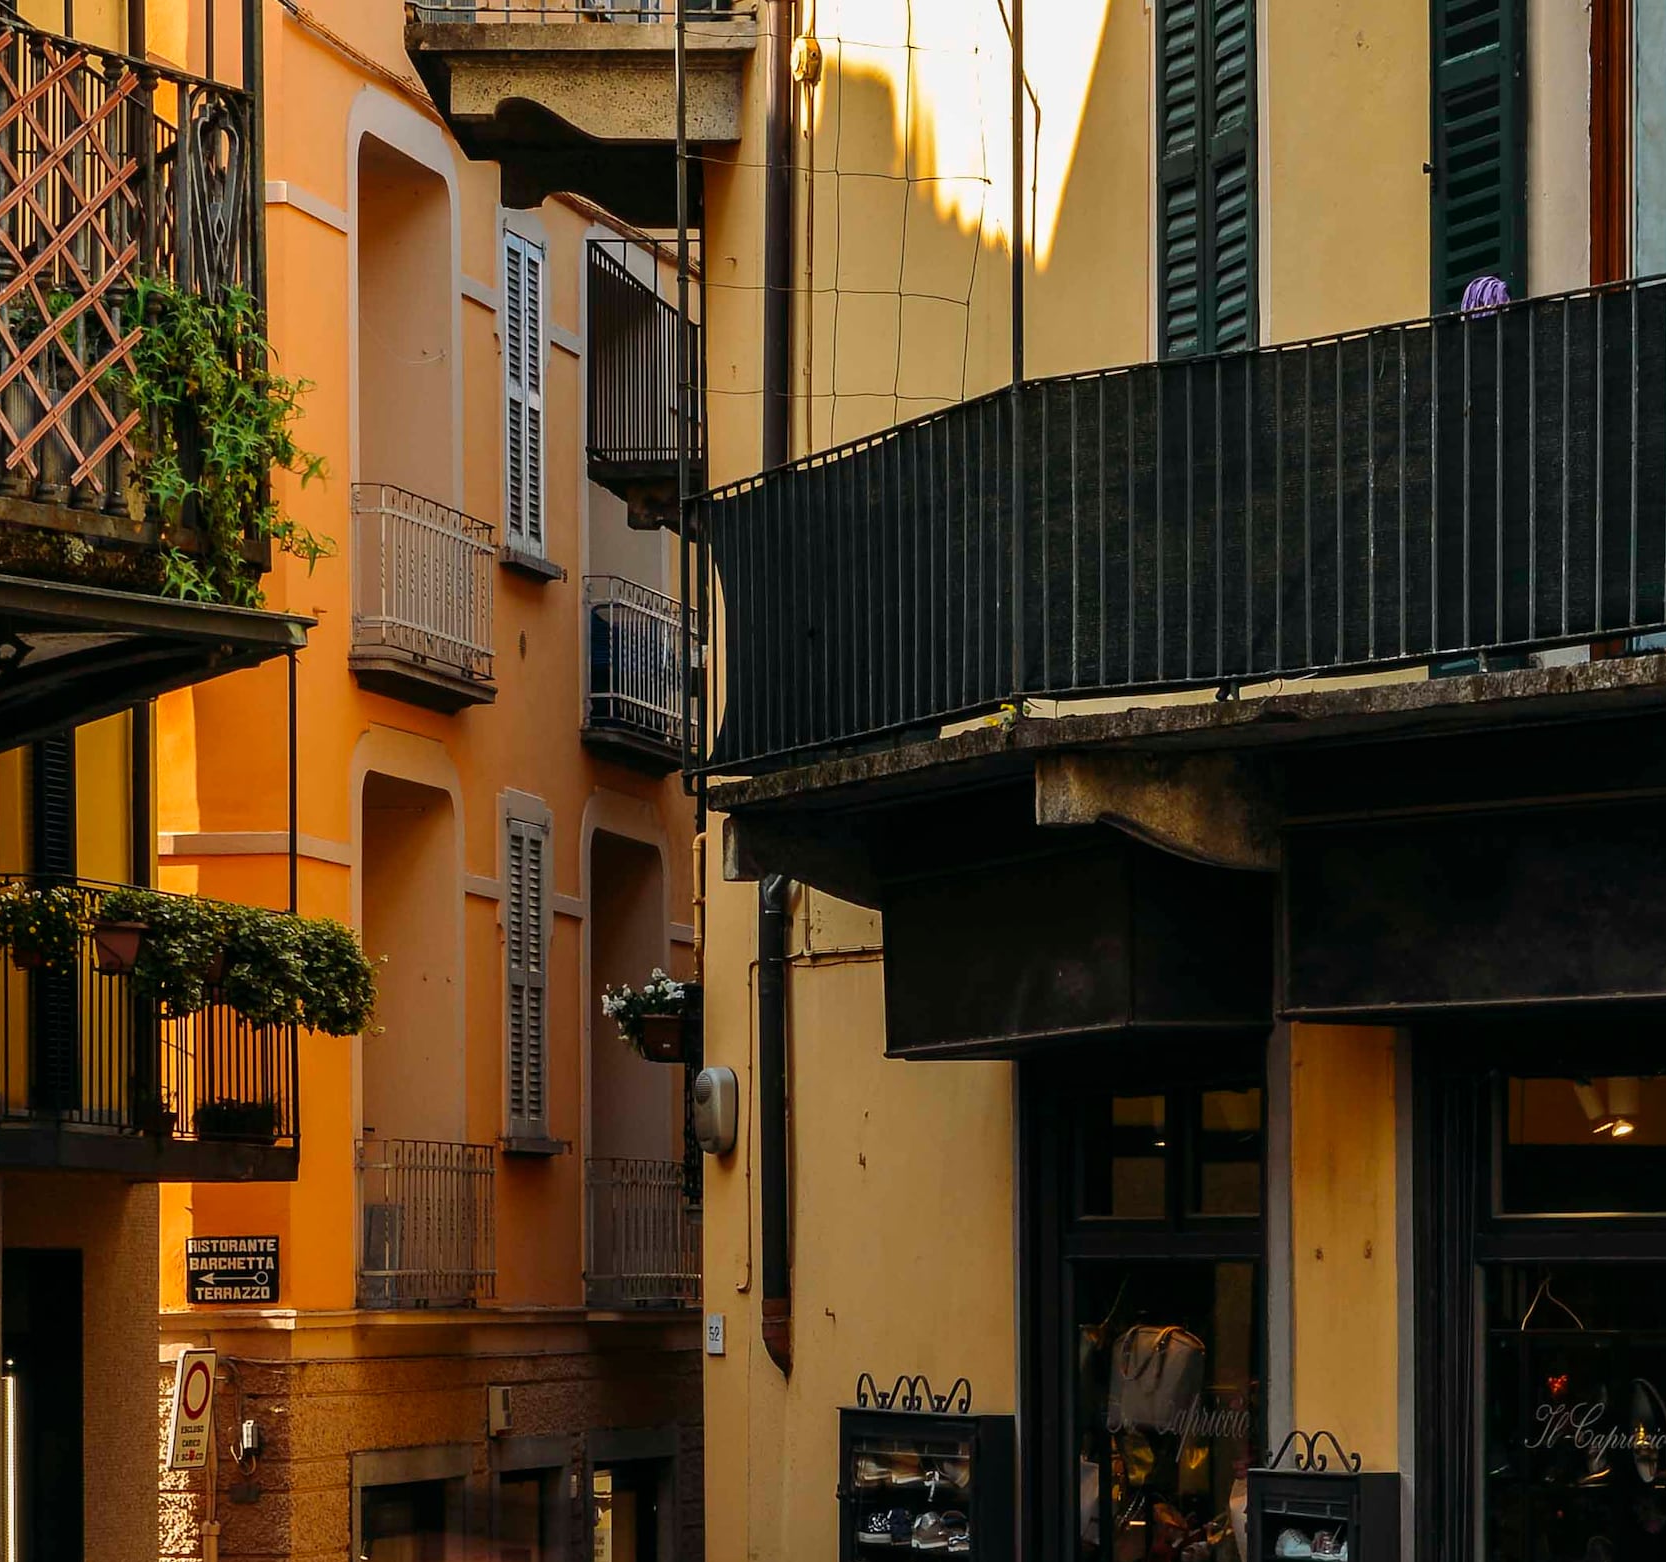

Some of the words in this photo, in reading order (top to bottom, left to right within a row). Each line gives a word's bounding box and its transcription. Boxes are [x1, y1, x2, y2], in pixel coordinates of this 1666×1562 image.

[188, 1239, 276, 1254] RISTORANTE
[189, 1256, 275, 1271] BARCHETTA
[195, 1286, 271, 1301] TERRAZZO
[709, 1325, 720, 1342] 52
[181, 1425, 205, 1434] ESCLUSO
[182, 1439, 201, 1448] CARICO
[181, 1453, 204, 1462] SCCO
